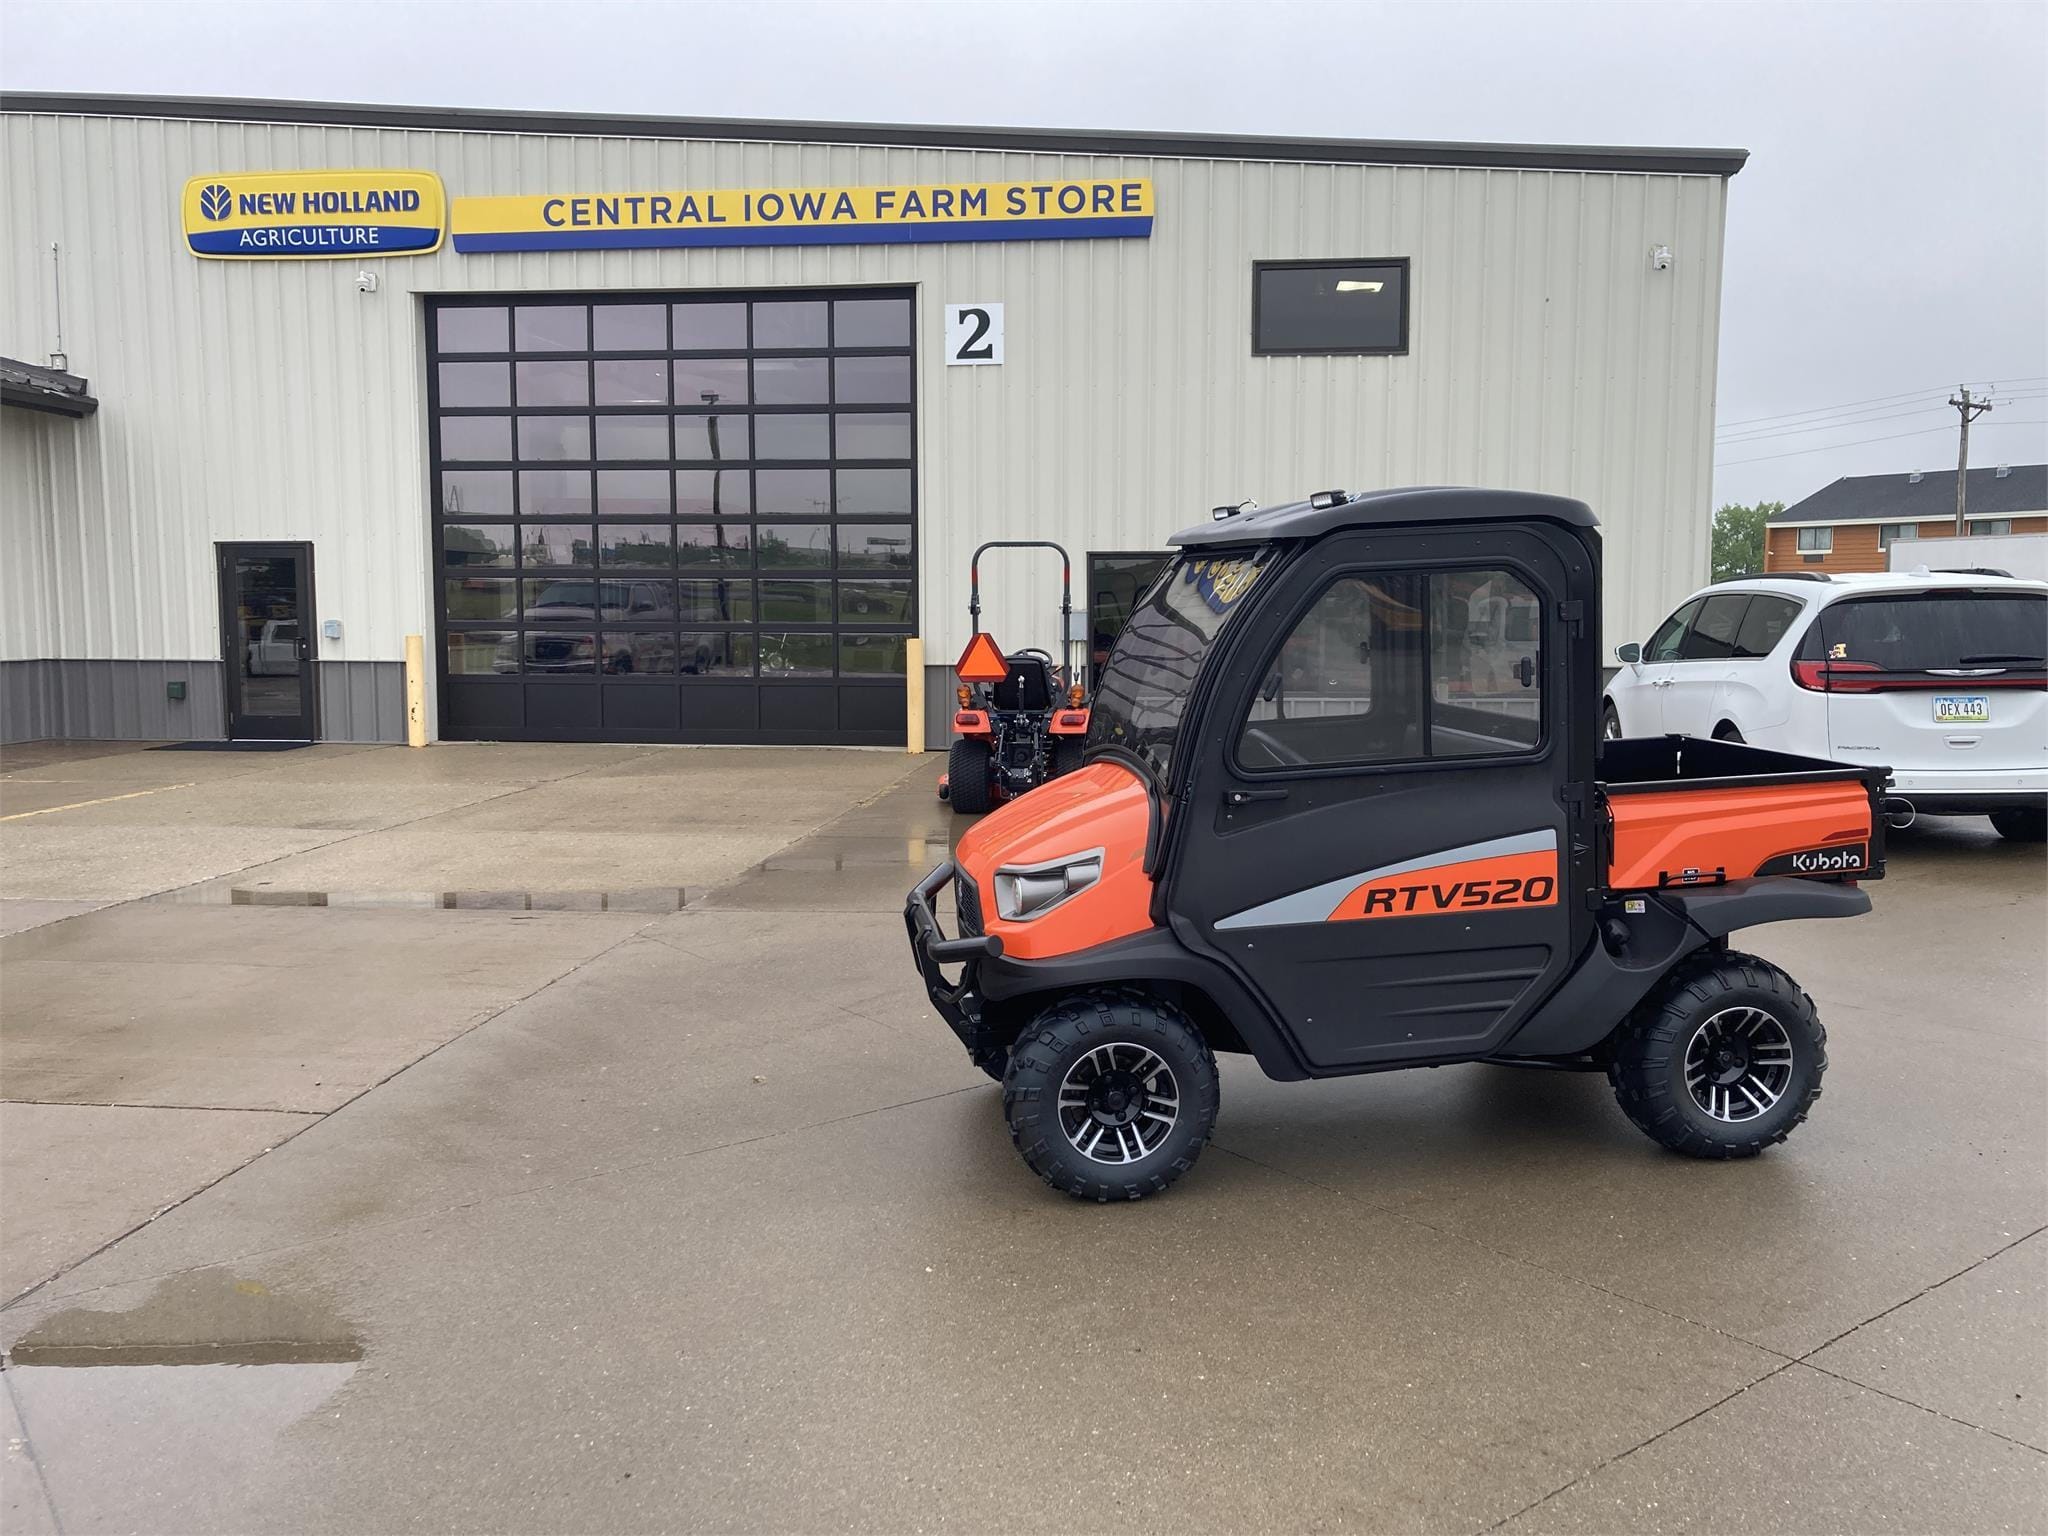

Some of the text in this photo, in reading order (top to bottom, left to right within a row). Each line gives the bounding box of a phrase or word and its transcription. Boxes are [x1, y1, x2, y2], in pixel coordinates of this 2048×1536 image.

[239, 189, 420, 216] NEW HOLLAND
[543, 183, 1143, 226] CENTRAL IOWA FARM STORE
[239, 227, 379, 246] AGRICULTURE
[956, 308, 994, 360] 2
[1963, 703, 1983, 716] 443
[1792, 851, 1861, 871] Kubota
[1363, 876, 1554, 914] RTV520
